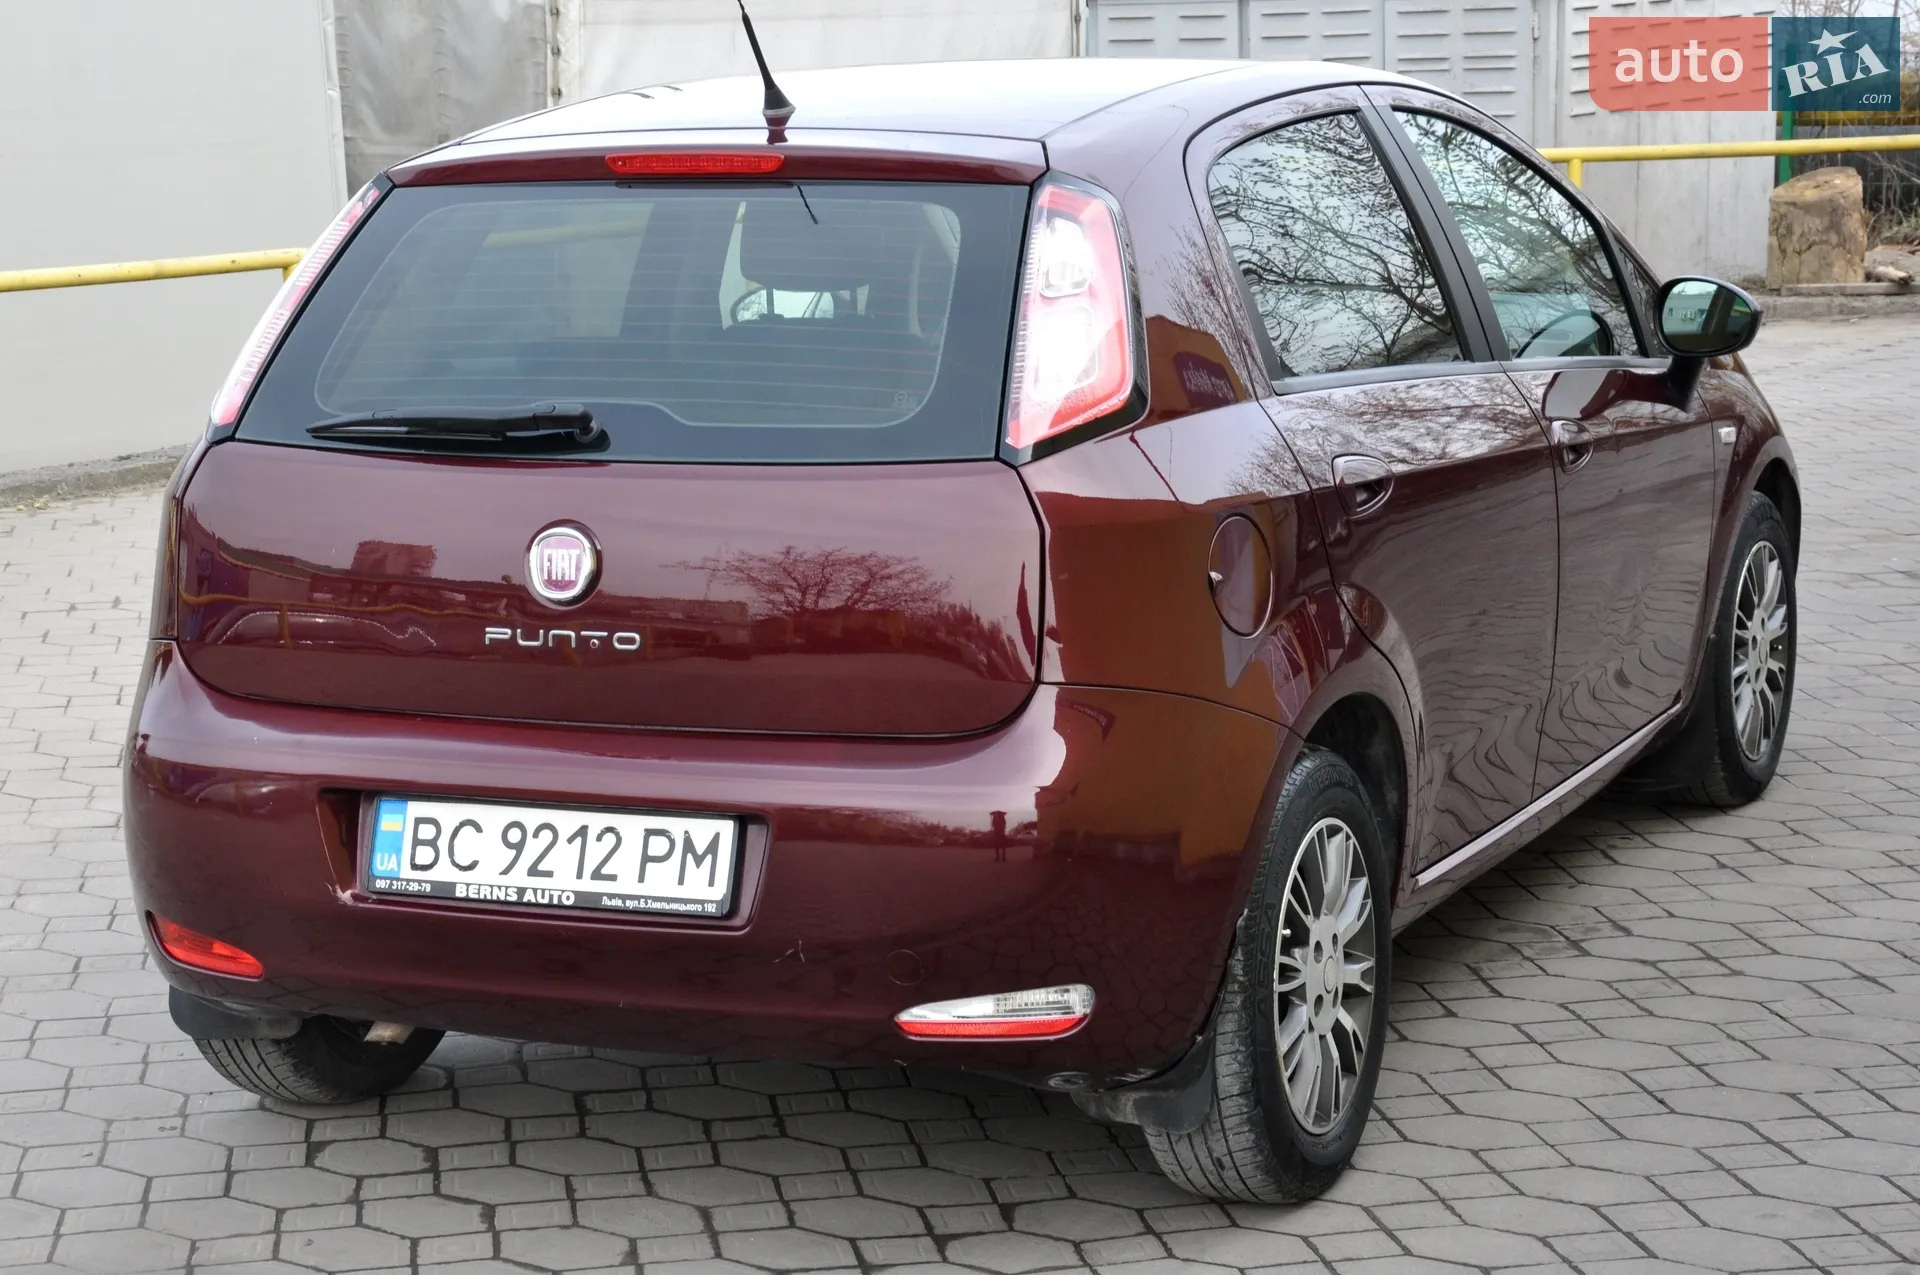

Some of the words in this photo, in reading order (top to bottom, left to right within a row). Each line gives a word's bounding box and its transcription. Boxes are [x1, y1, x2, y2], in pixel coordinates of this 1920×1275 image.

[543, 548, 581, 581] FIAT
[376, 852, 399, 872] UA
[410, 817, 484, 873] BC
[498, 820, 623, 882] 9212
[637, 827, 721, 888] PM
[375, 879, 390, 890] 097
[391, 880, 432, 893] 317-29-79
[455, 883, 518, 901] BERNS
[523, 888, 576, 906] AUTO
[601, 896, 625, 908] Львів,
[704, 903, 717, 913] 192
[1255, 901, 1277, 1052] LASSA
